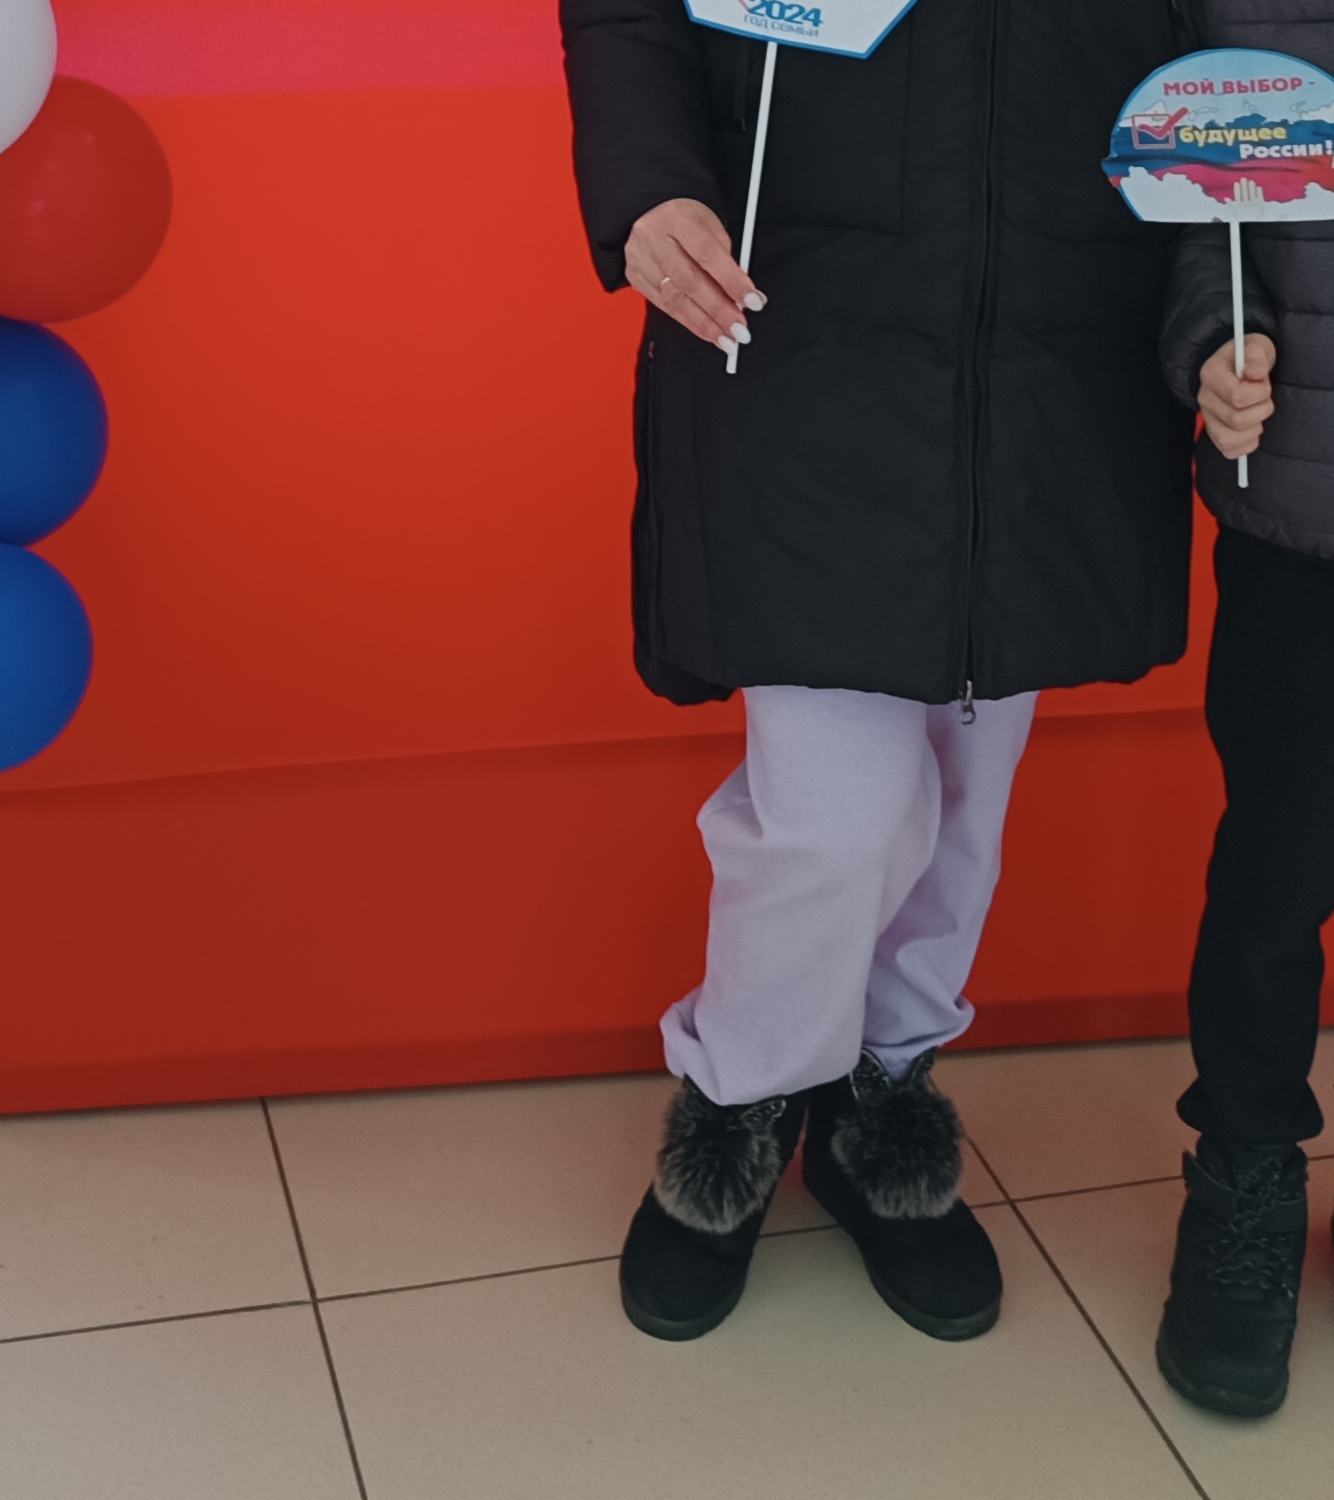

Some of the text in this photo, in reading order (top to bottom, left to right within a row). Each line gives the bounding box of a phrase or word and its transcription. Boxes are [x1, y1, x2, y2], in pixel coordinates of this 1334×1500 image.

[743, 14, 769, 29] ГОД
[1163, 78, 1215, 96] МОЙ
[1222, 76, 1303, 95] ВЫБОР
[1179, 126, 1288, 147] будущее
[1239, 140, 1334, 160] России!
